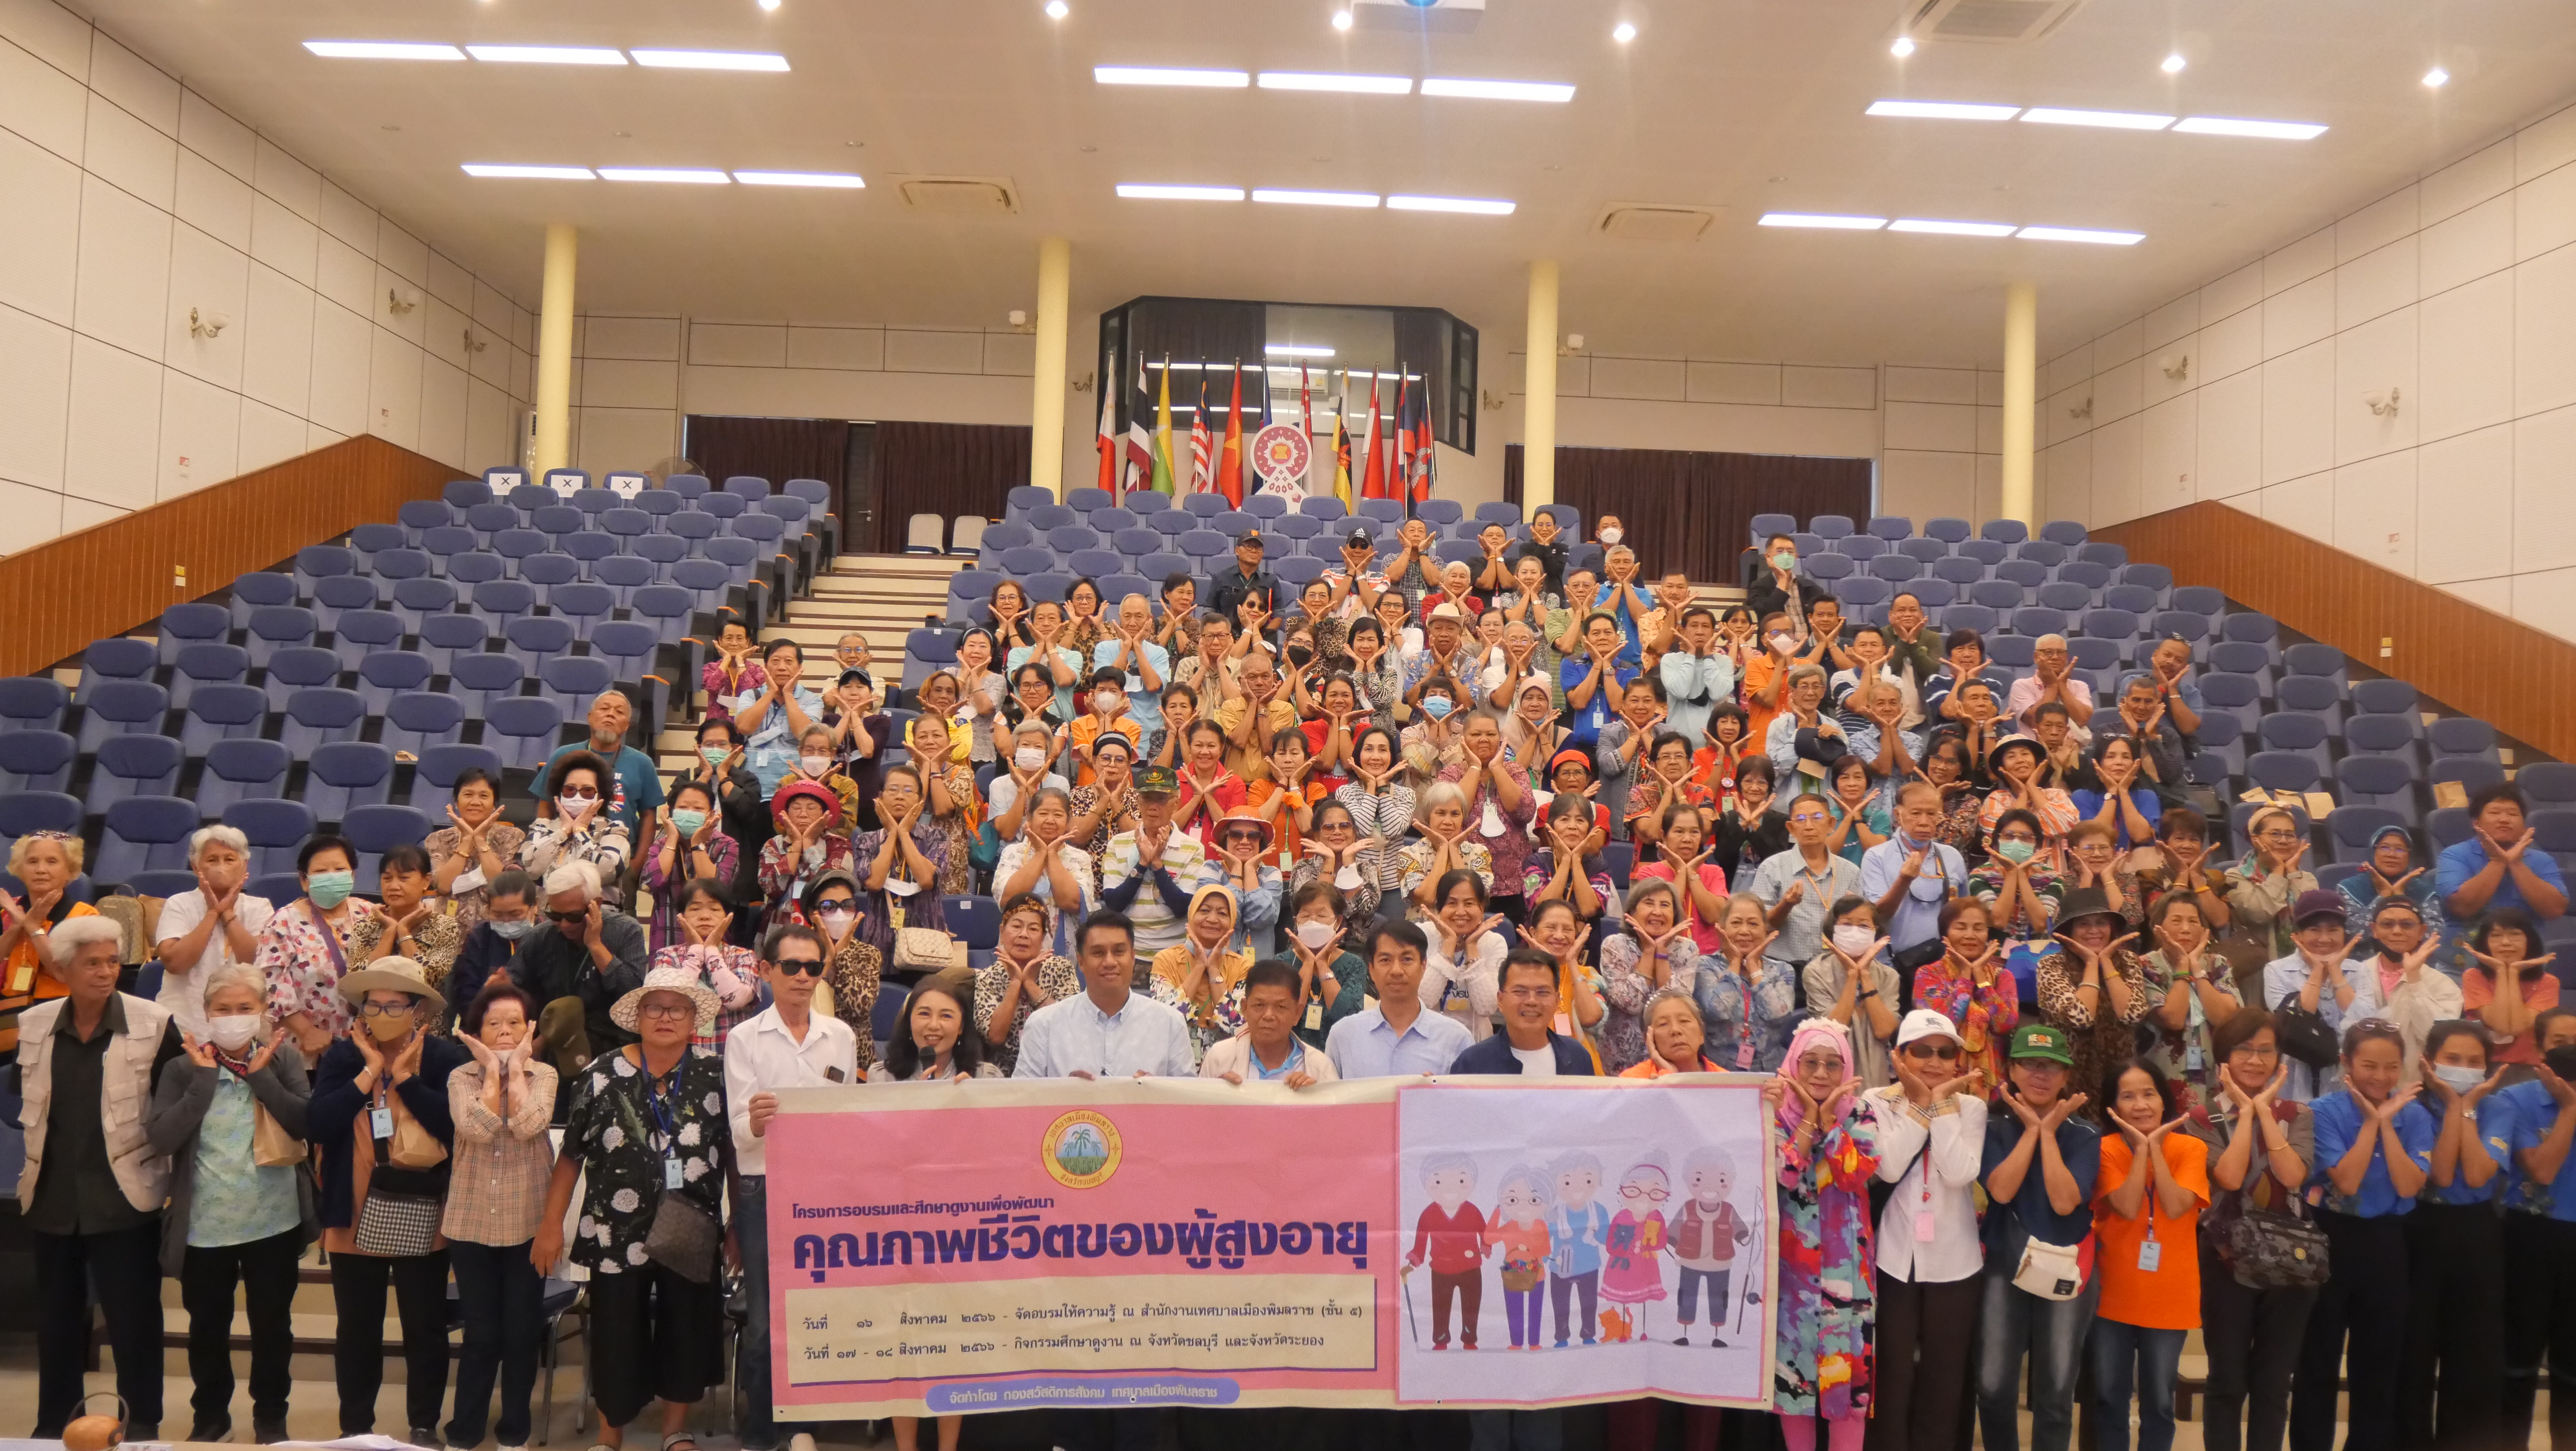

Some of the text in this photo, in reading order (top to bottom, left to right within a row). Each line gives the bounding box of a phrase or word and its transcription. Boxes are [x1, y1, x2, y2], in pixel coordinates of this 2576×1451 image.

[792, 1194, 1054, 1218] โครงการอบรมและศึกษาดูงานเพื่อพัฒนา
[794, 1208, 1367, 1283] คุณภาพชีวิตของผู้สูงอายุ
[803, 1313, 828, 1330] วันที่
[856, 1319, 873, 1329] ๑๖
[900, 1311, 947, 1325] สิงหาคม
[961, 1313, 995, 1323] ๒๕๖๖
[1015, 1303, 1116, 1323] จัดอบรมให้ความรู้
[1123, 1307, 1134, 1317] ณ
[1141, 1302, 1314, 1317] สำนักงานเทศบาลเมืองพิมลราช
[1321, 1298, 1343, 1318] (ชั้น
[1350, 1306, 1362, 1318] ๕)
[804, 1343, 829, 1360] วันที่
[836, 1349, 856, 1359] ๑๗
[876, 1347, 893, 1358] ๑๘
[899, 1342, 946, 1355] สิงหาคม
[960, 1342, 995, 1353] ๒๕๖๖
[1015, 1334, 1123, 1353] กิจกรรมศึกษาดูงาน
[1129, 1337, 1142, 1347] ณ
[1148, 1333, 1218, 1352] จังหวัดชลบุรี
[1225, 1333, 1324, 1347] และจังหวัดระยอง
[950, 1384, 1217, 1404] จัดทำโดย กองสวัสดิการสังคม เทศบาลเมืองพิมลราช
